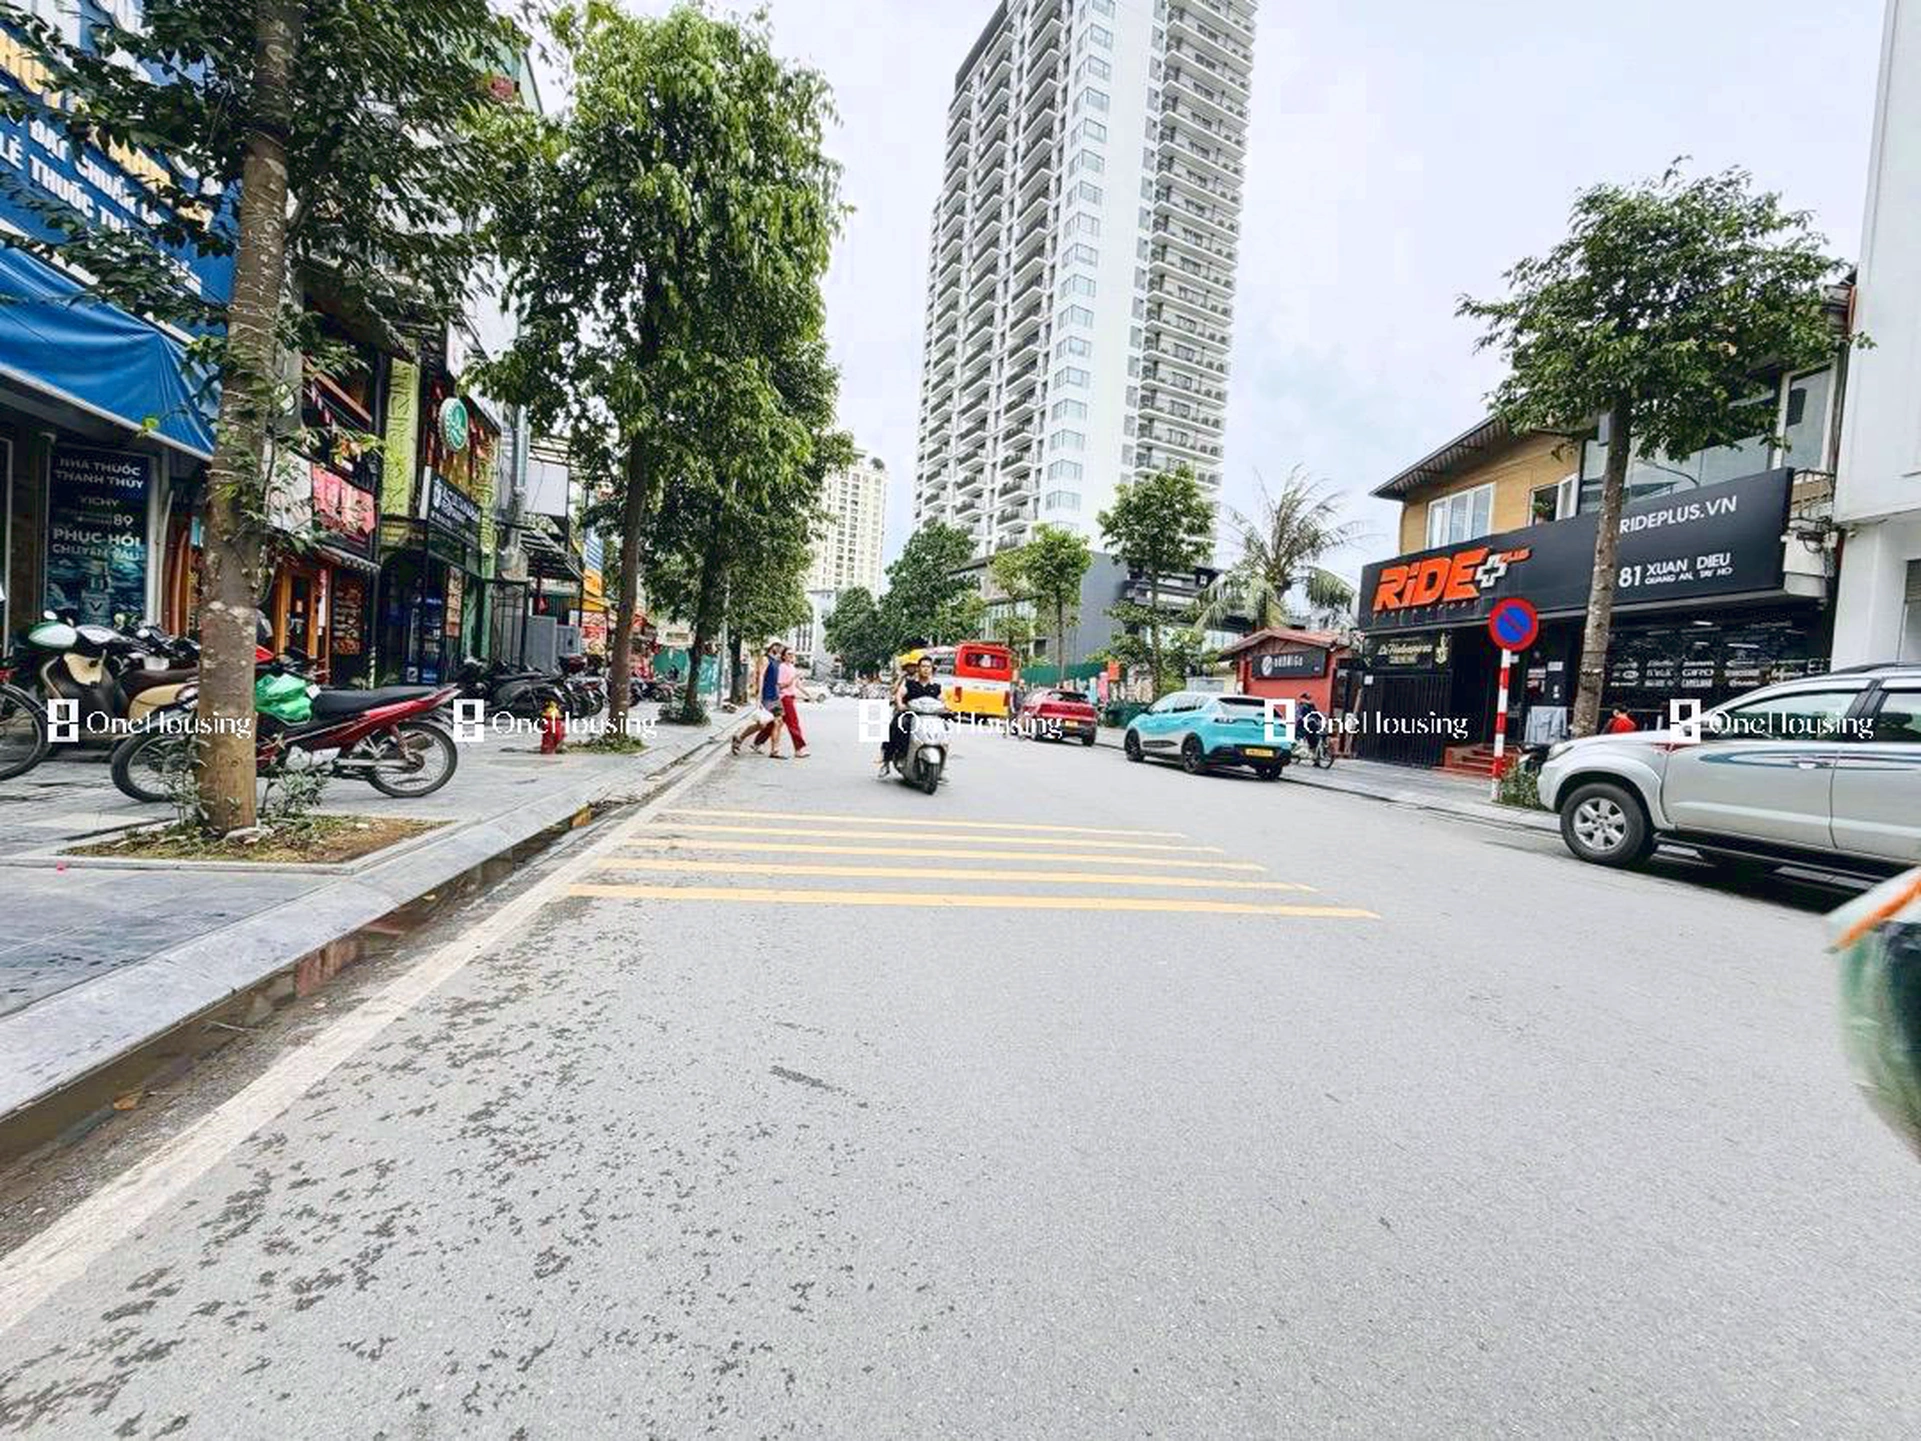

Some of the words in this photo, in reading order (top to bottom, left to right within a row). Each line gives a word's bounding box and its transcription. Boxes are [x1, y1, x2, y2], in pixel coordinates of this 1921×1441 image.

[113, 514, 134, 527] 89
[1619, 495, 1737, 534] RIDEPLUS.VN
[1618, 565, 1642, 588] 81
[1646, 558, 1689, 576] XUAN
